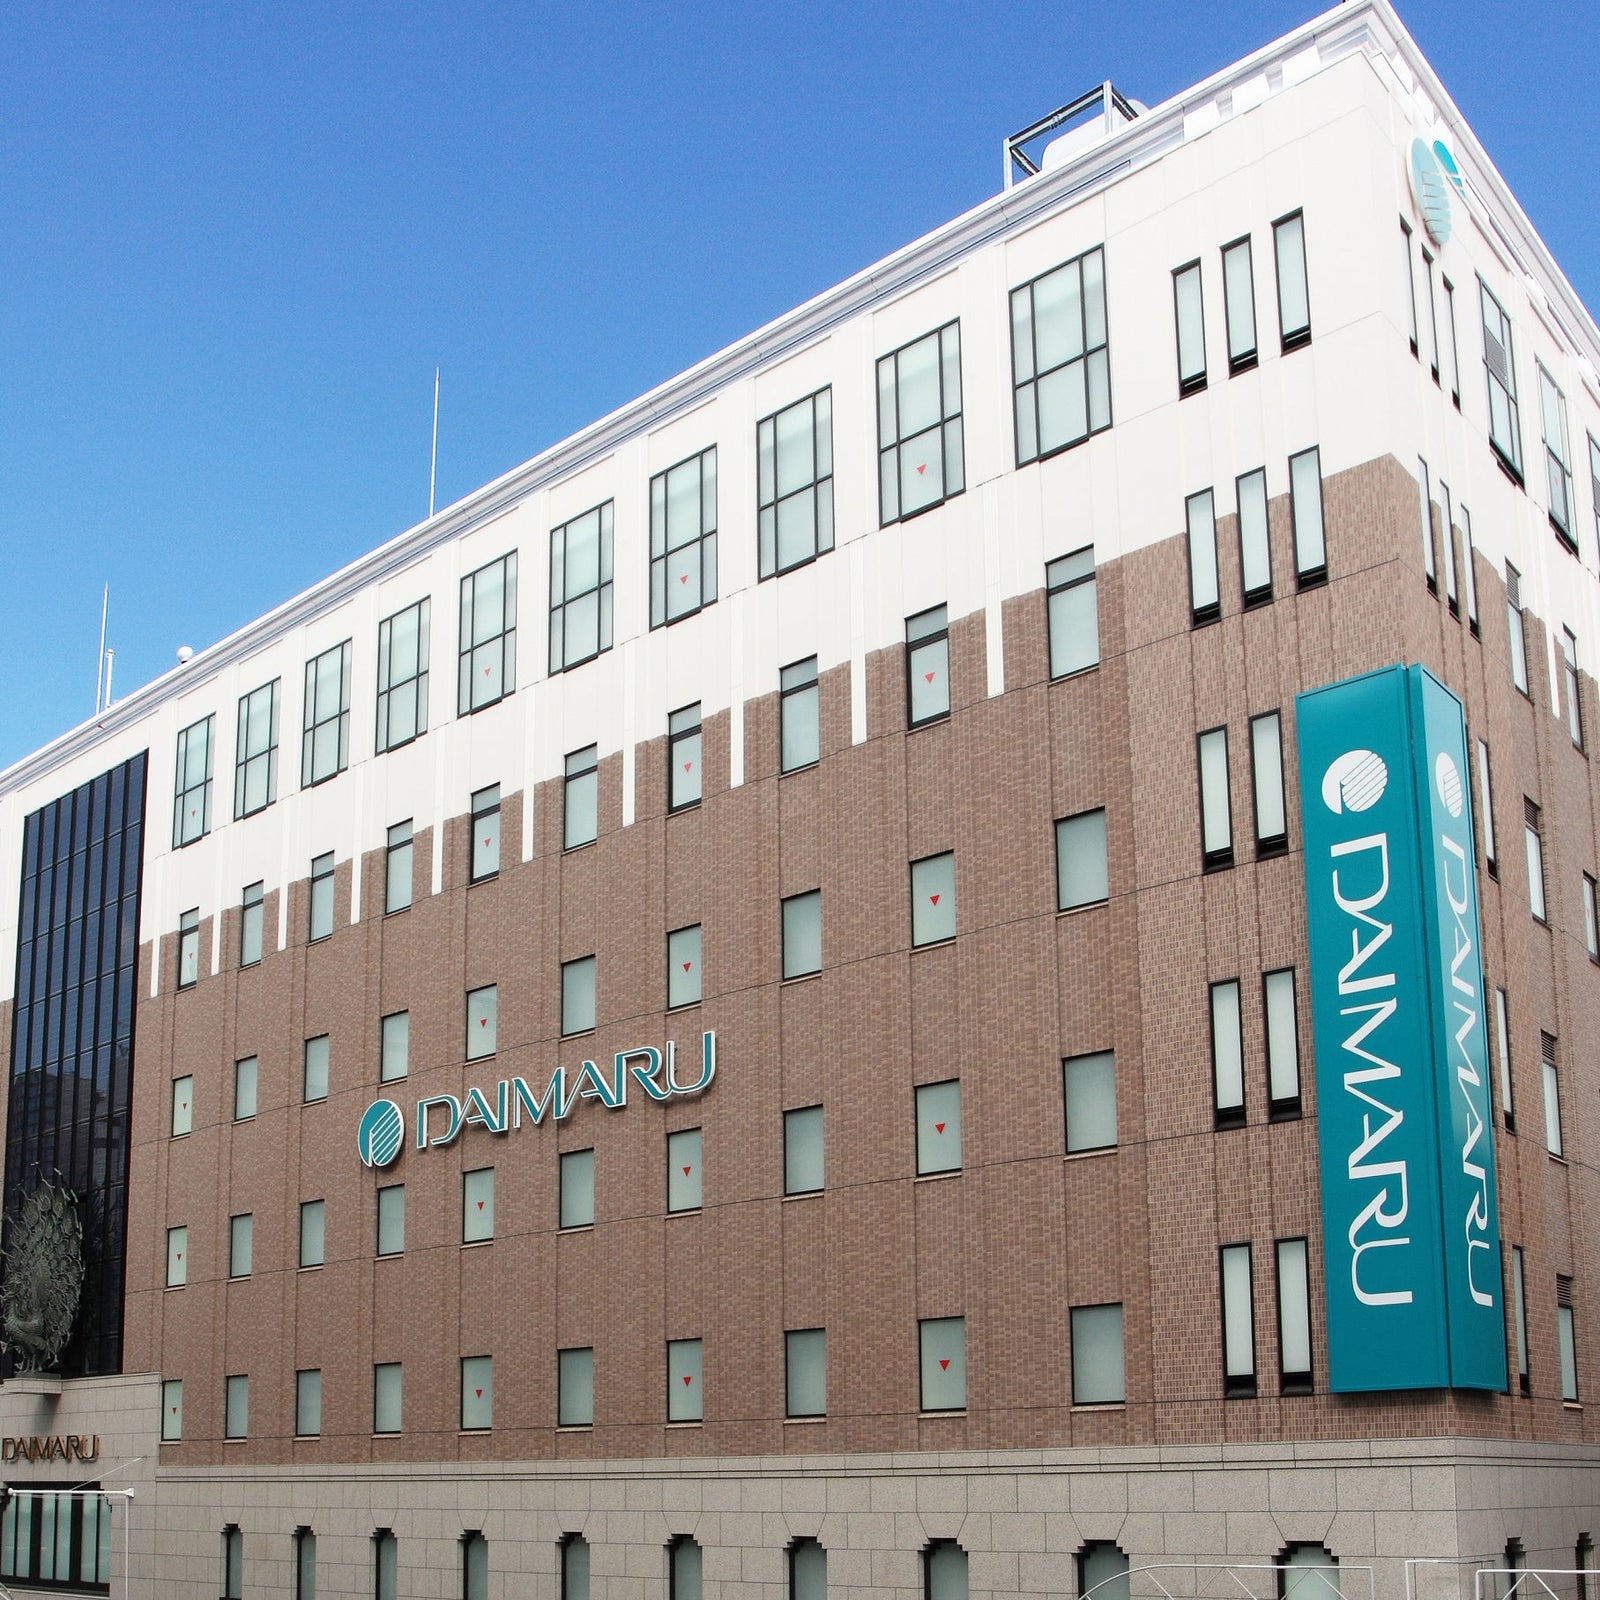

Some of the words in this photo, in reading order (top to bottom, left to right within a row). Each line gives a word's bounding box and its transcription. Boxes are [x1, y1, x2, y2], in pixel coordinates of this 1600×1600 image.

[417, 1030, 716, 1149] DAIMARU
[1330, 832, 1413, 1306] DAIMARU
[1442, 834, 1493, 1307] DAIMARU
[1, 1434, 97, 1461] DAIMARU
